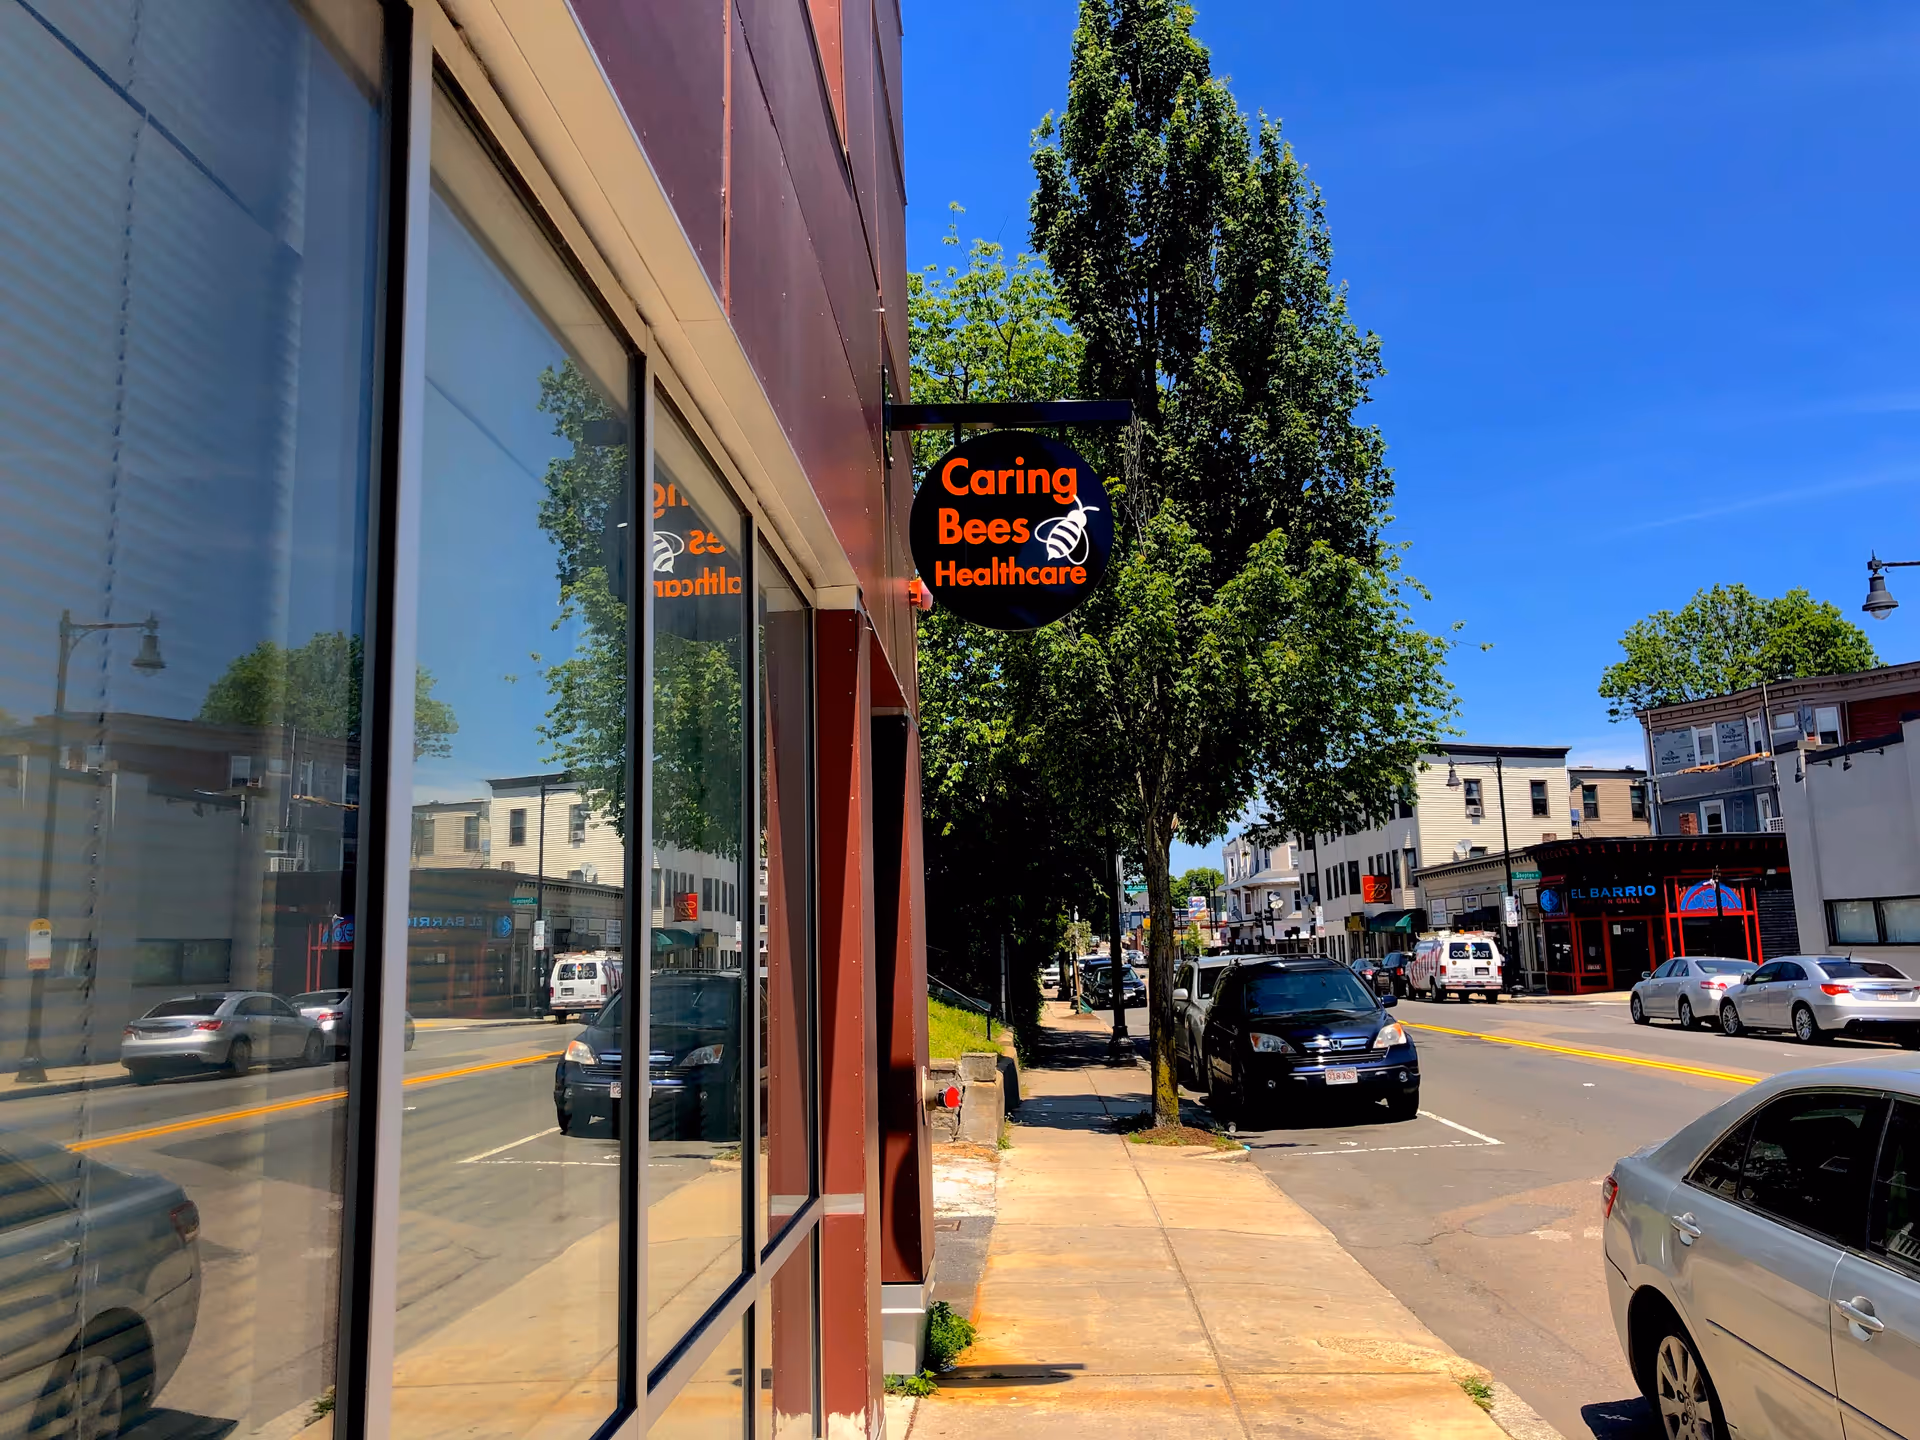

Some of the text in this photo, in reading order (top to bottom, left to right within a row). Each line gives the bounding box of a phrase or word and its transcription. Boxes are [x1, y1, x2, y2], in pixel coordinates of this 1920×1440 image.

[941, 456, 1078, 505] Caring
[938, 507, 1031, 545] Bees
[935, 556, 1087, 587] Healthcare
[1571, 885, 1656, 899] EL BARRIO
[1451, 950, 1490, 958] COMCAST
